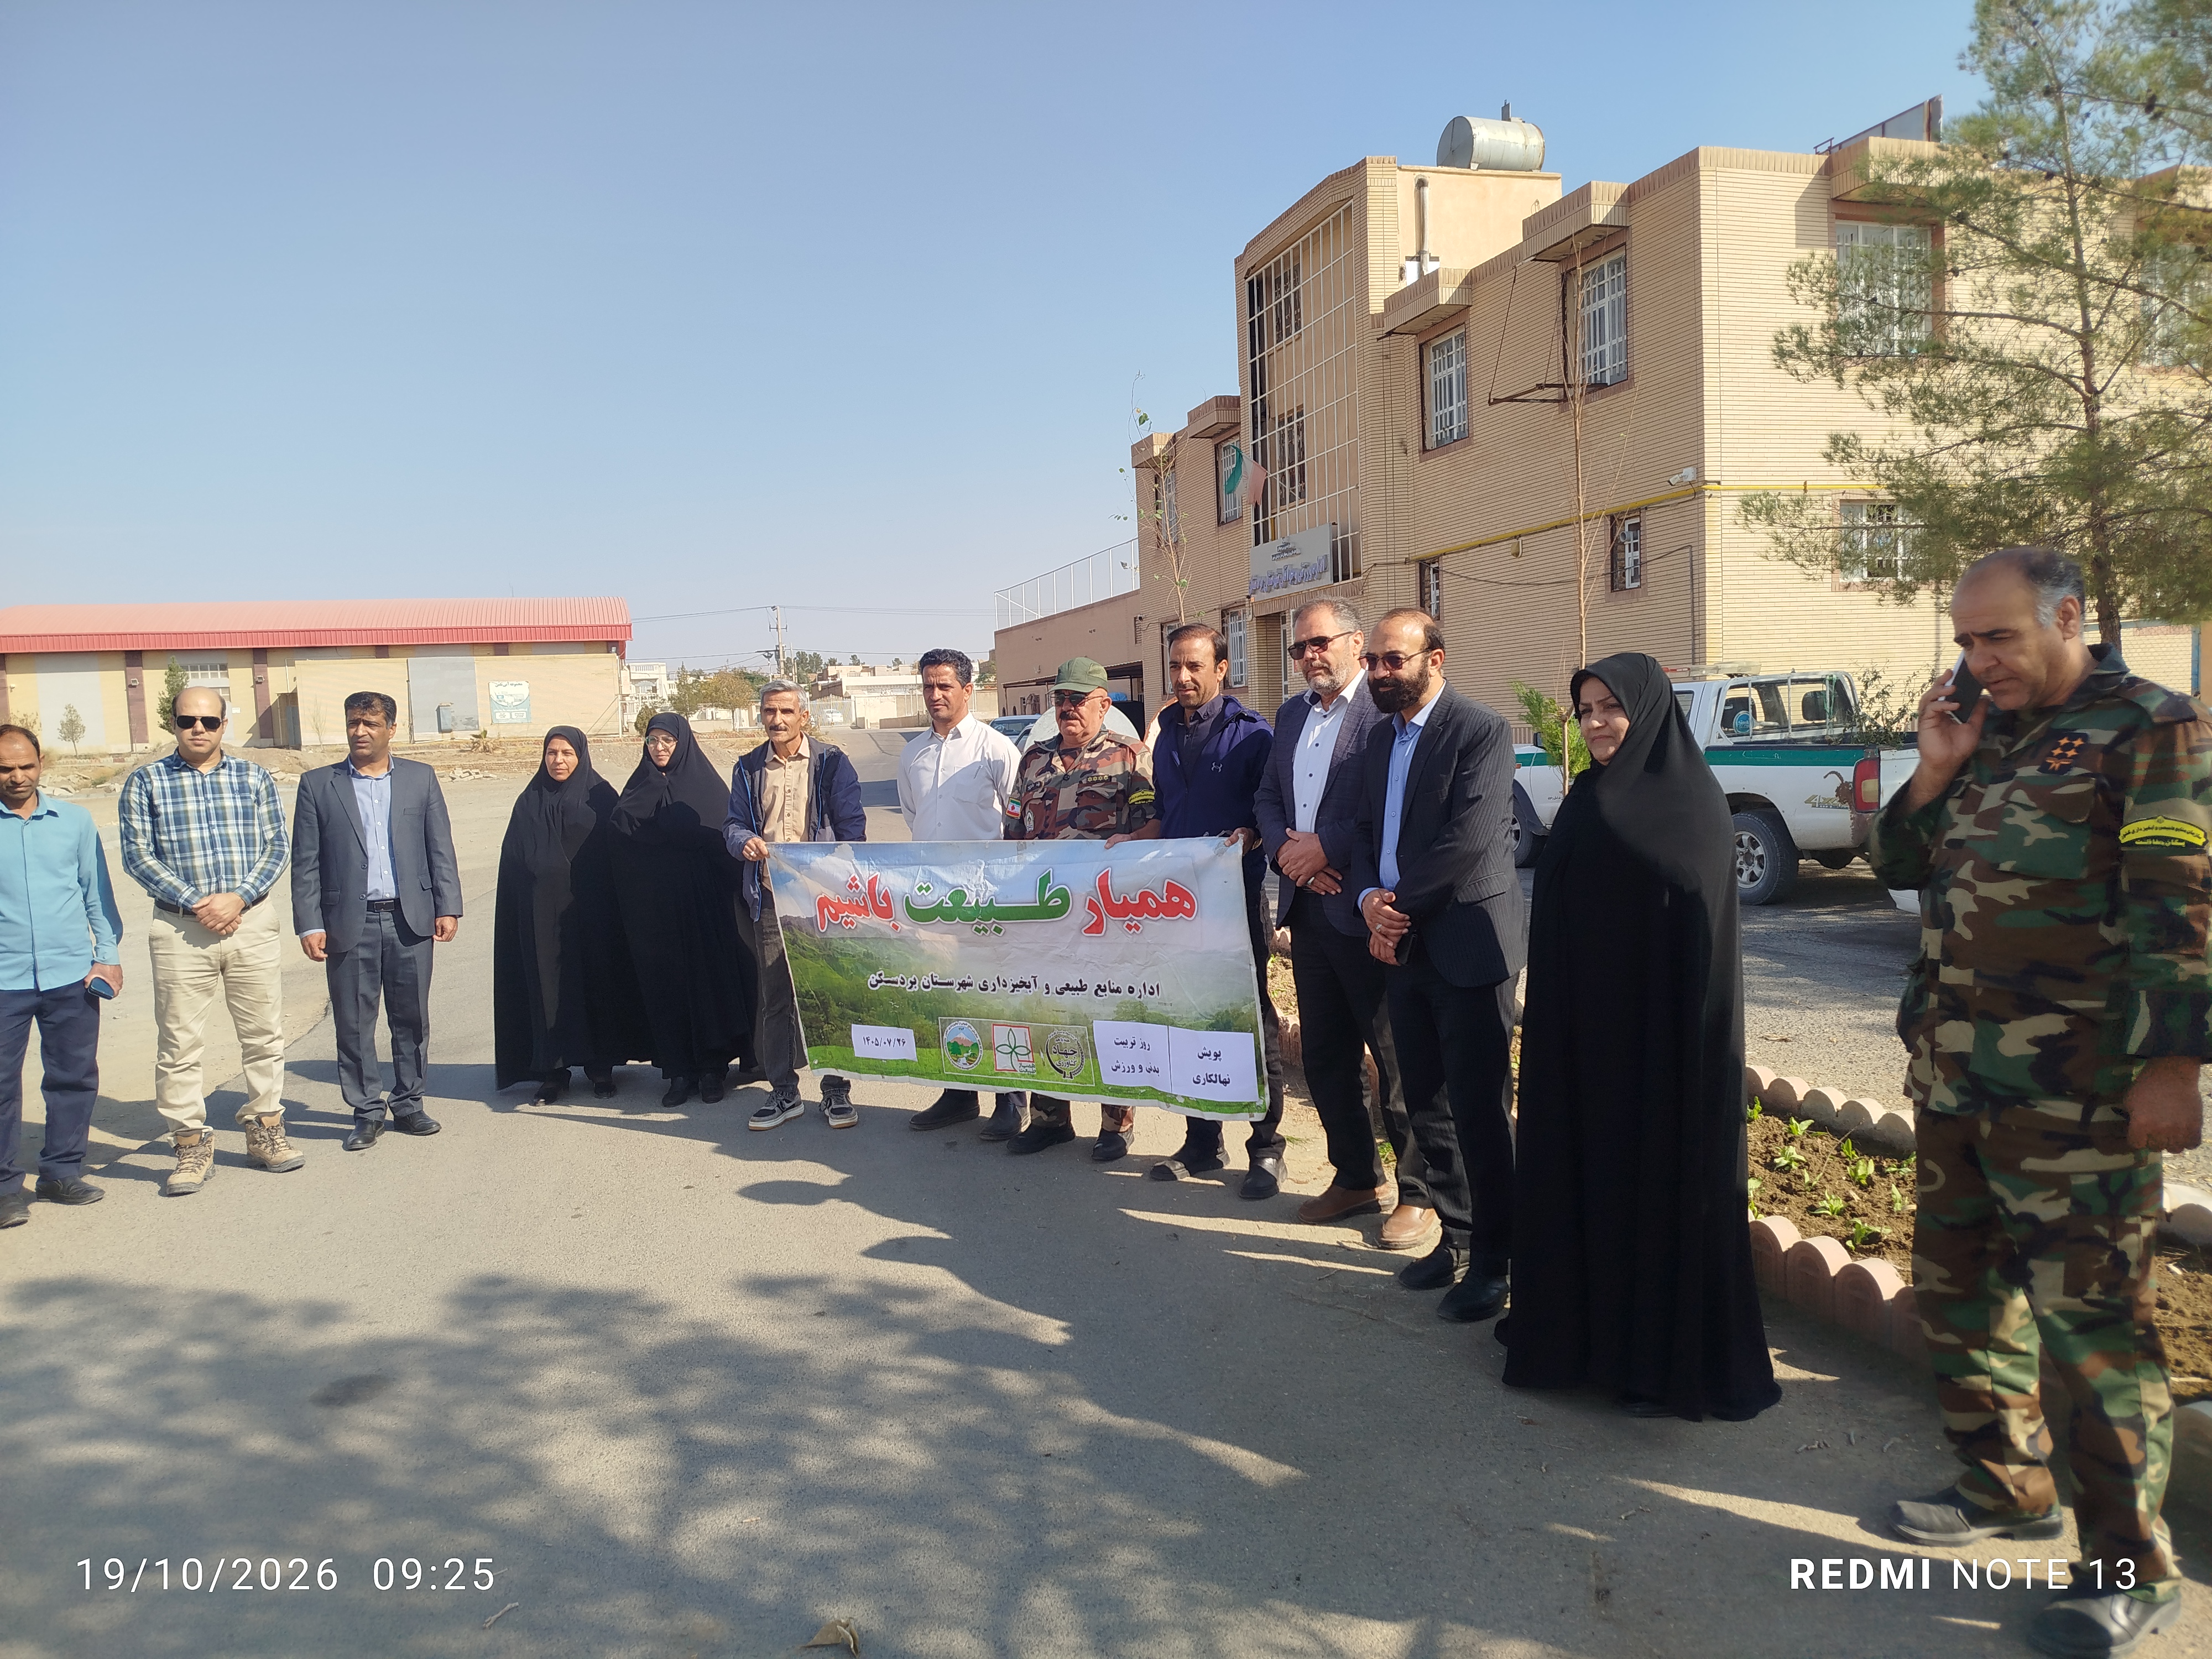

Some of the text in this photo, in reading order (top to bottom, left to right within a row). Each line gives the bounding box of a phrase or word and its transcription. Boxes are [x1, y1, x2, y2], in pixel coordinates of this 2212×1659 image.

[816, 868, 1197, 936] همیار طبیعت باشیم
[869, 972, 1160, 999] اداره منابع طبیعی و آبخیزداری شهرستان بردسکن
[1114, 1036, 1151, 1051] روز تربیت
[1052, 1044, 1078, 1059] جهاد
[1197, 1046, 1222, 1062] پویش
[1056, 1059, 1078, 1068] کشاورزی
[1111, 1060, 1160, 1077] بدنی و ورزش
[1192, 1072, 1231, 1087] نهالکاری
